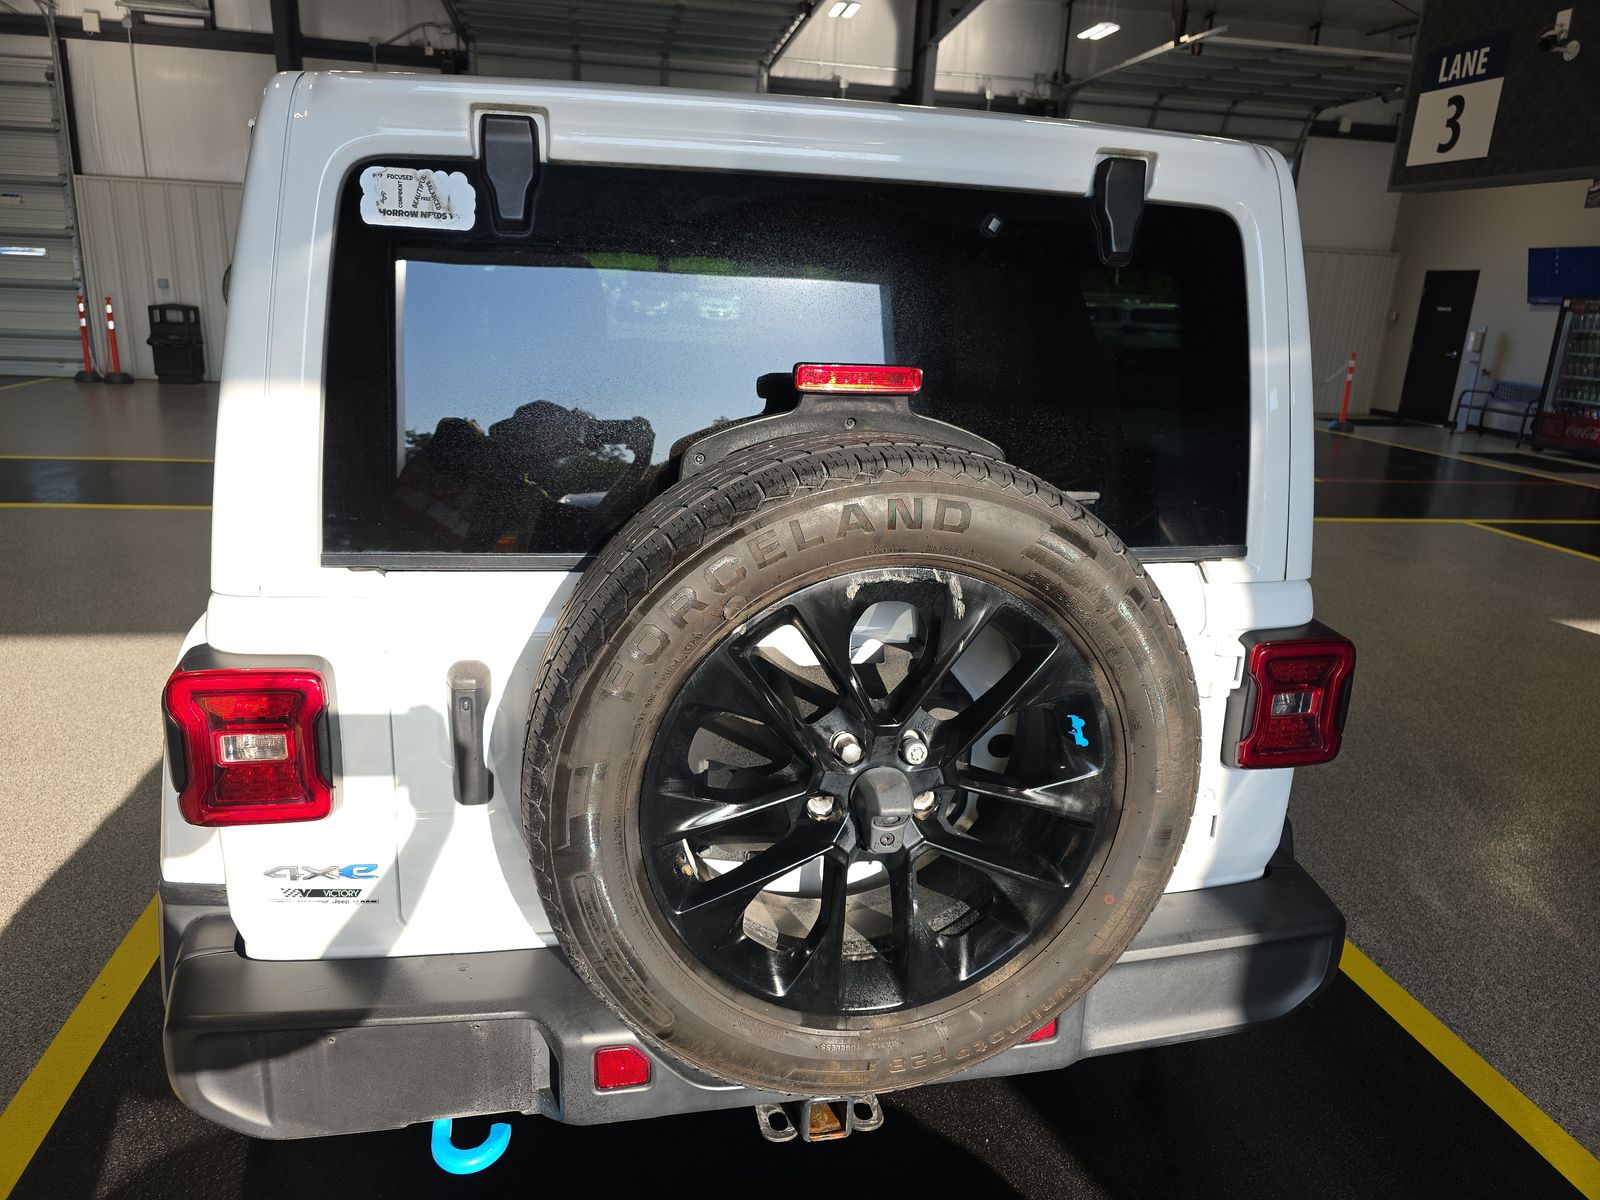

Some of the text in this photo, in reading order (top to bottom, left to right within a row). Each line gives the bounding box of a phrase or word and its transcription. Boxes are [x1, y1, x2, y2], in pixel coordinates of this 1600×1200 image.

[1438, 46, 1491, 83] LANE
[1436, 94, 1466, 154] 3
[386, 173, 414, 181] FOCUSED
[412, 175, 428, 209] BEAUTIFUL
[425, 180, 442, 211] BALANCED
[601, 497, 972, 703] FORCELAND
[322, 889, 361, 898] VICTORY
